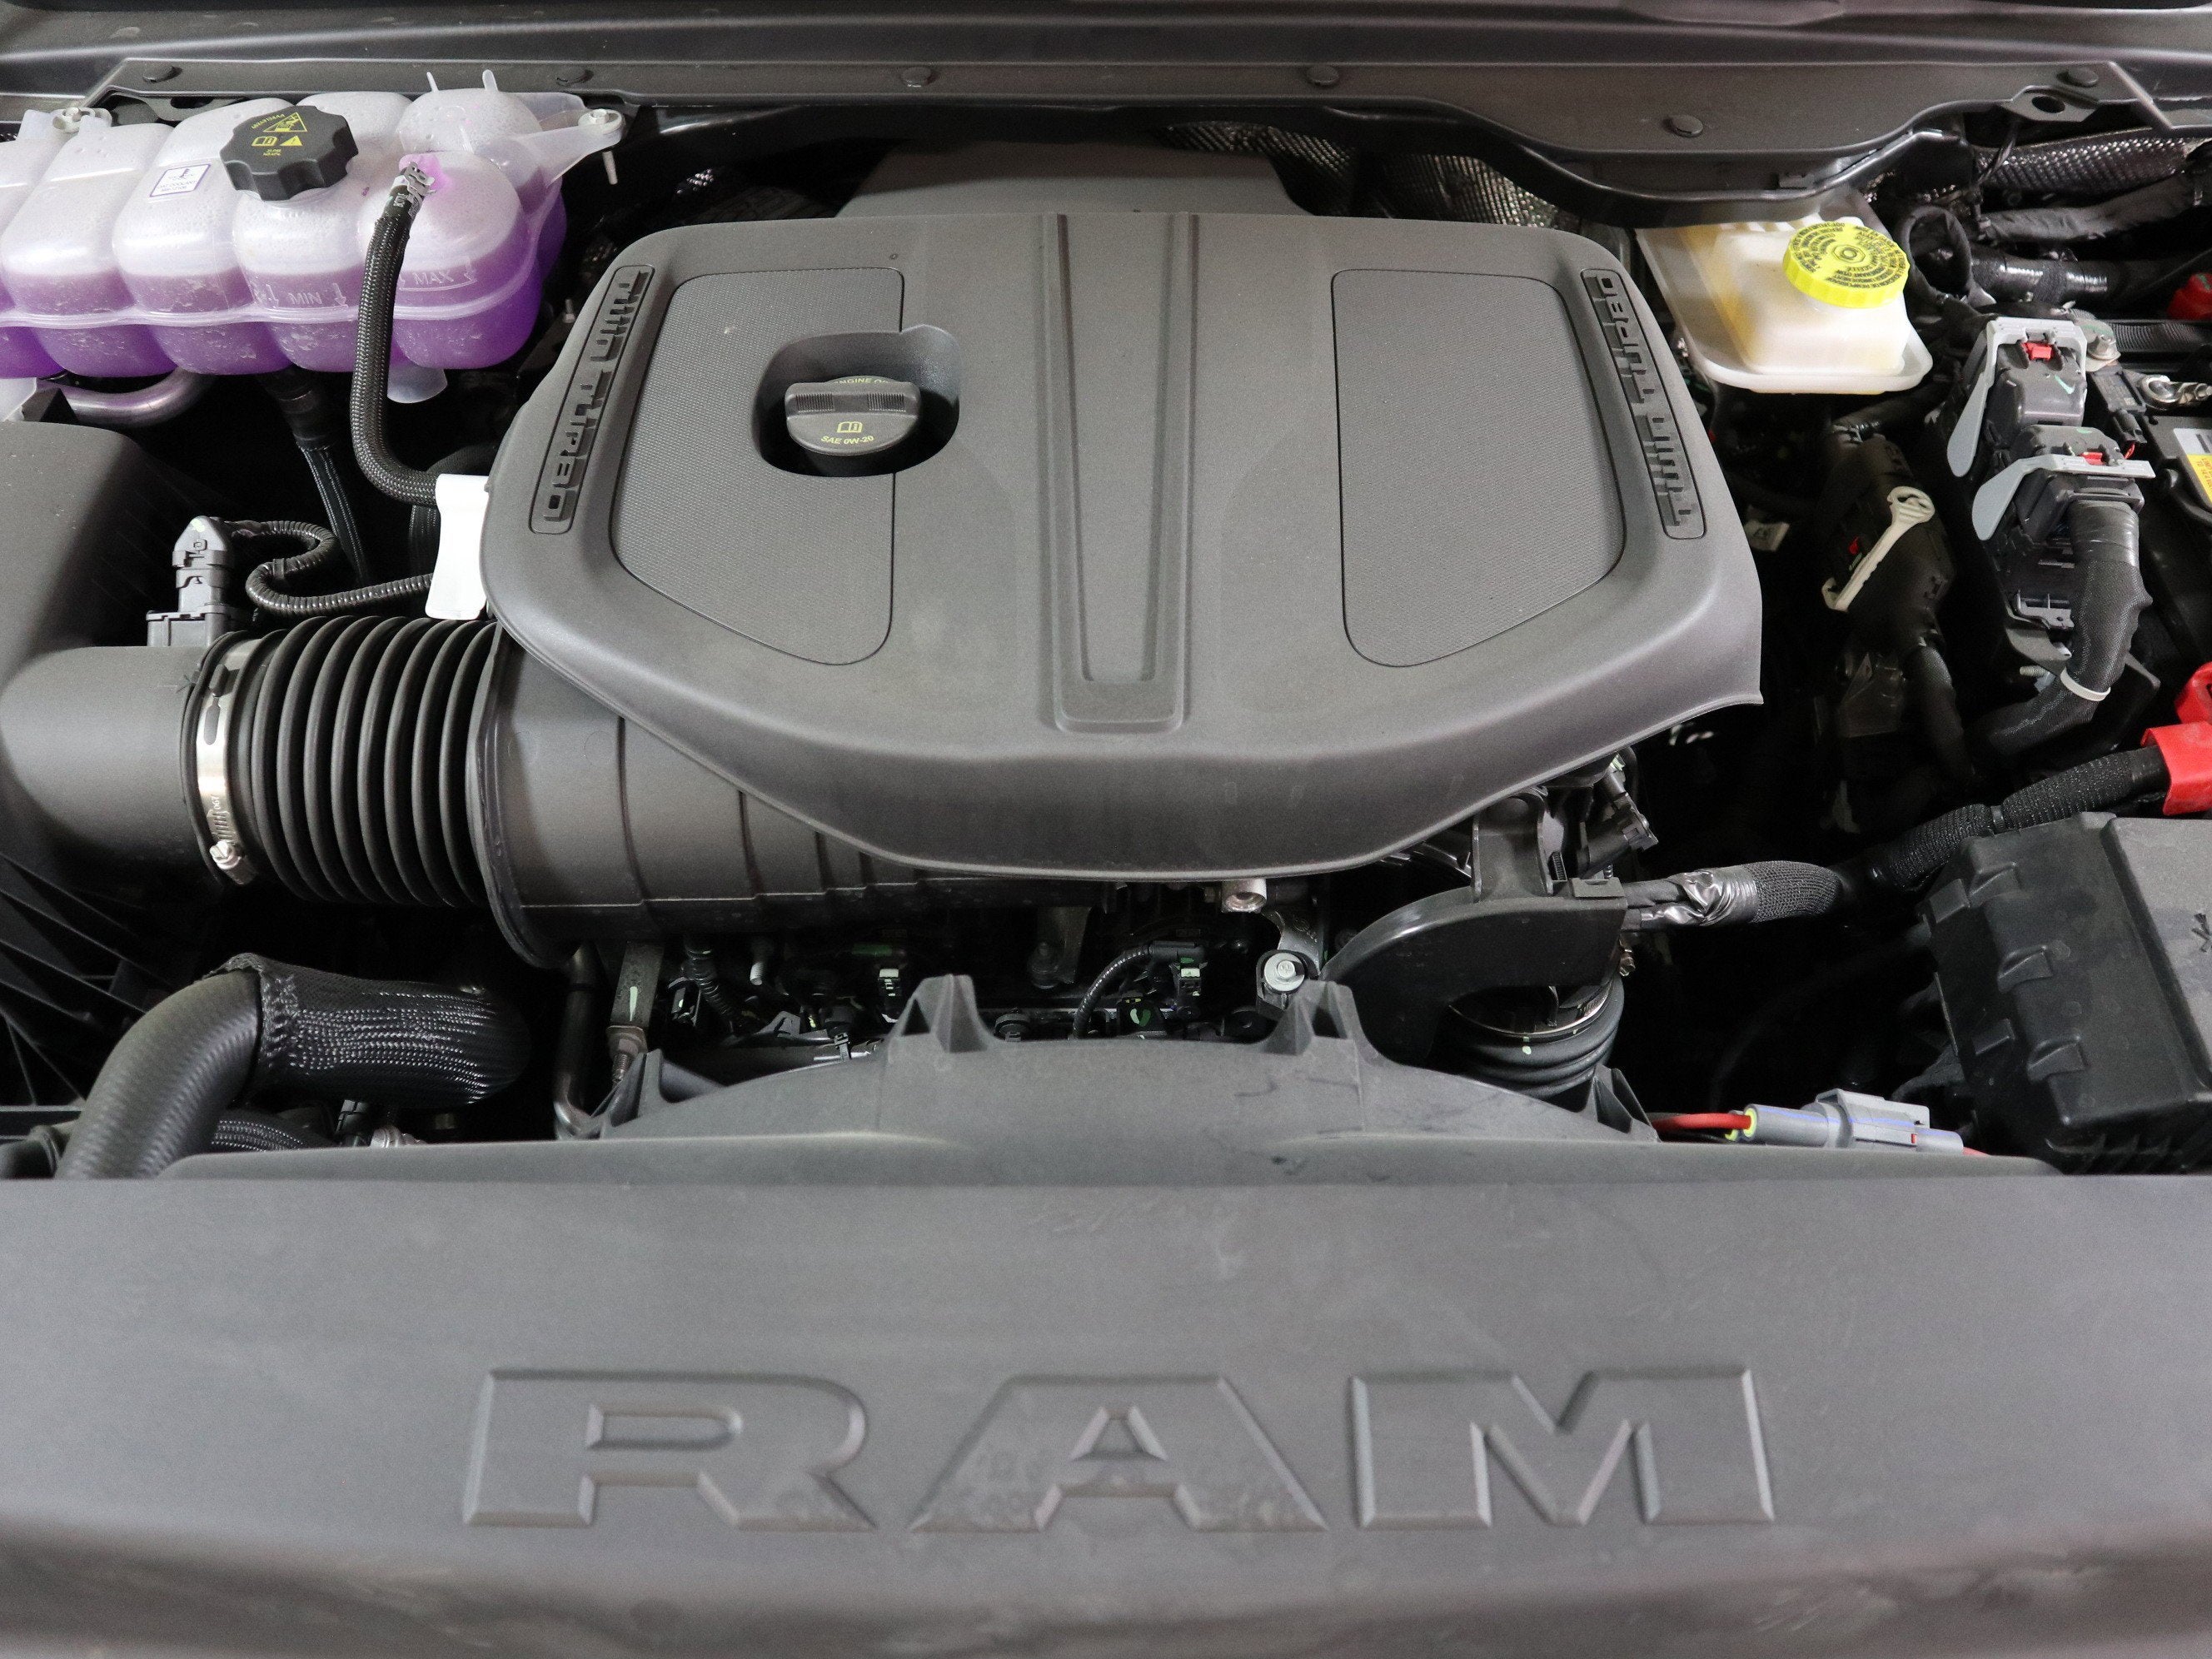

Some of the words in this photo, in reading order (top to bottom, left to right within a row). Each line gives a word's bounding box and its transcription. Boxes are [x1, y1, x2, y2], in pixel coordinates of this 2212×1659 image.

[288, 291, 322, 305] MIN
[415, 271, 454, 286] MAX
[589, 271, 649, 363] TWIN
[1582, 275, 1655, 404] TURBO
[542, 368, 613, 521] TURBO
[820, 435, 843, 444] SAE
[1632, 415, 1692, 527] TWIN
[462, 1366, 1776, 1535] RAM
